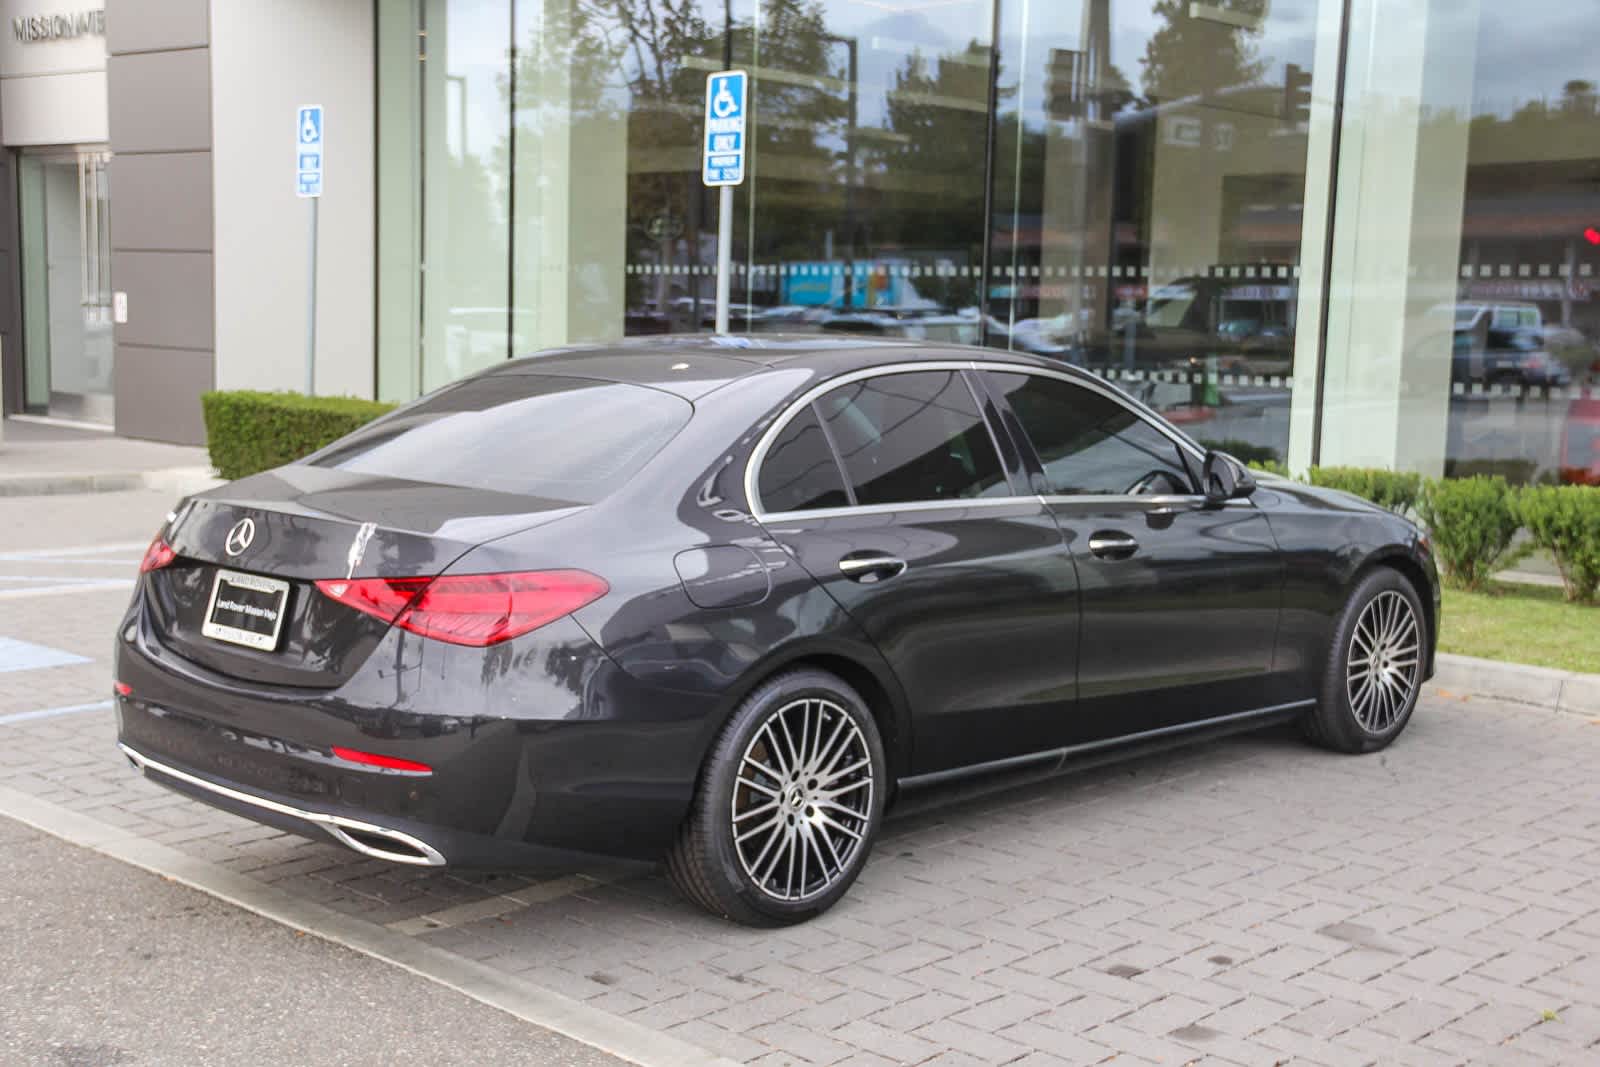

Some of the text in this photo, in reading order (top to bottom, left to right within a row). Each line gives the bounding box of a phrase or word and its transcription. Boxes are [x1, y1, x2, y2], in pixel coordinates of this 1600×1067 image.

[12, 14, 77, 41] MISSION
[216, 599, 230, 610] Land
[230, 600, 246, 613] Rover
